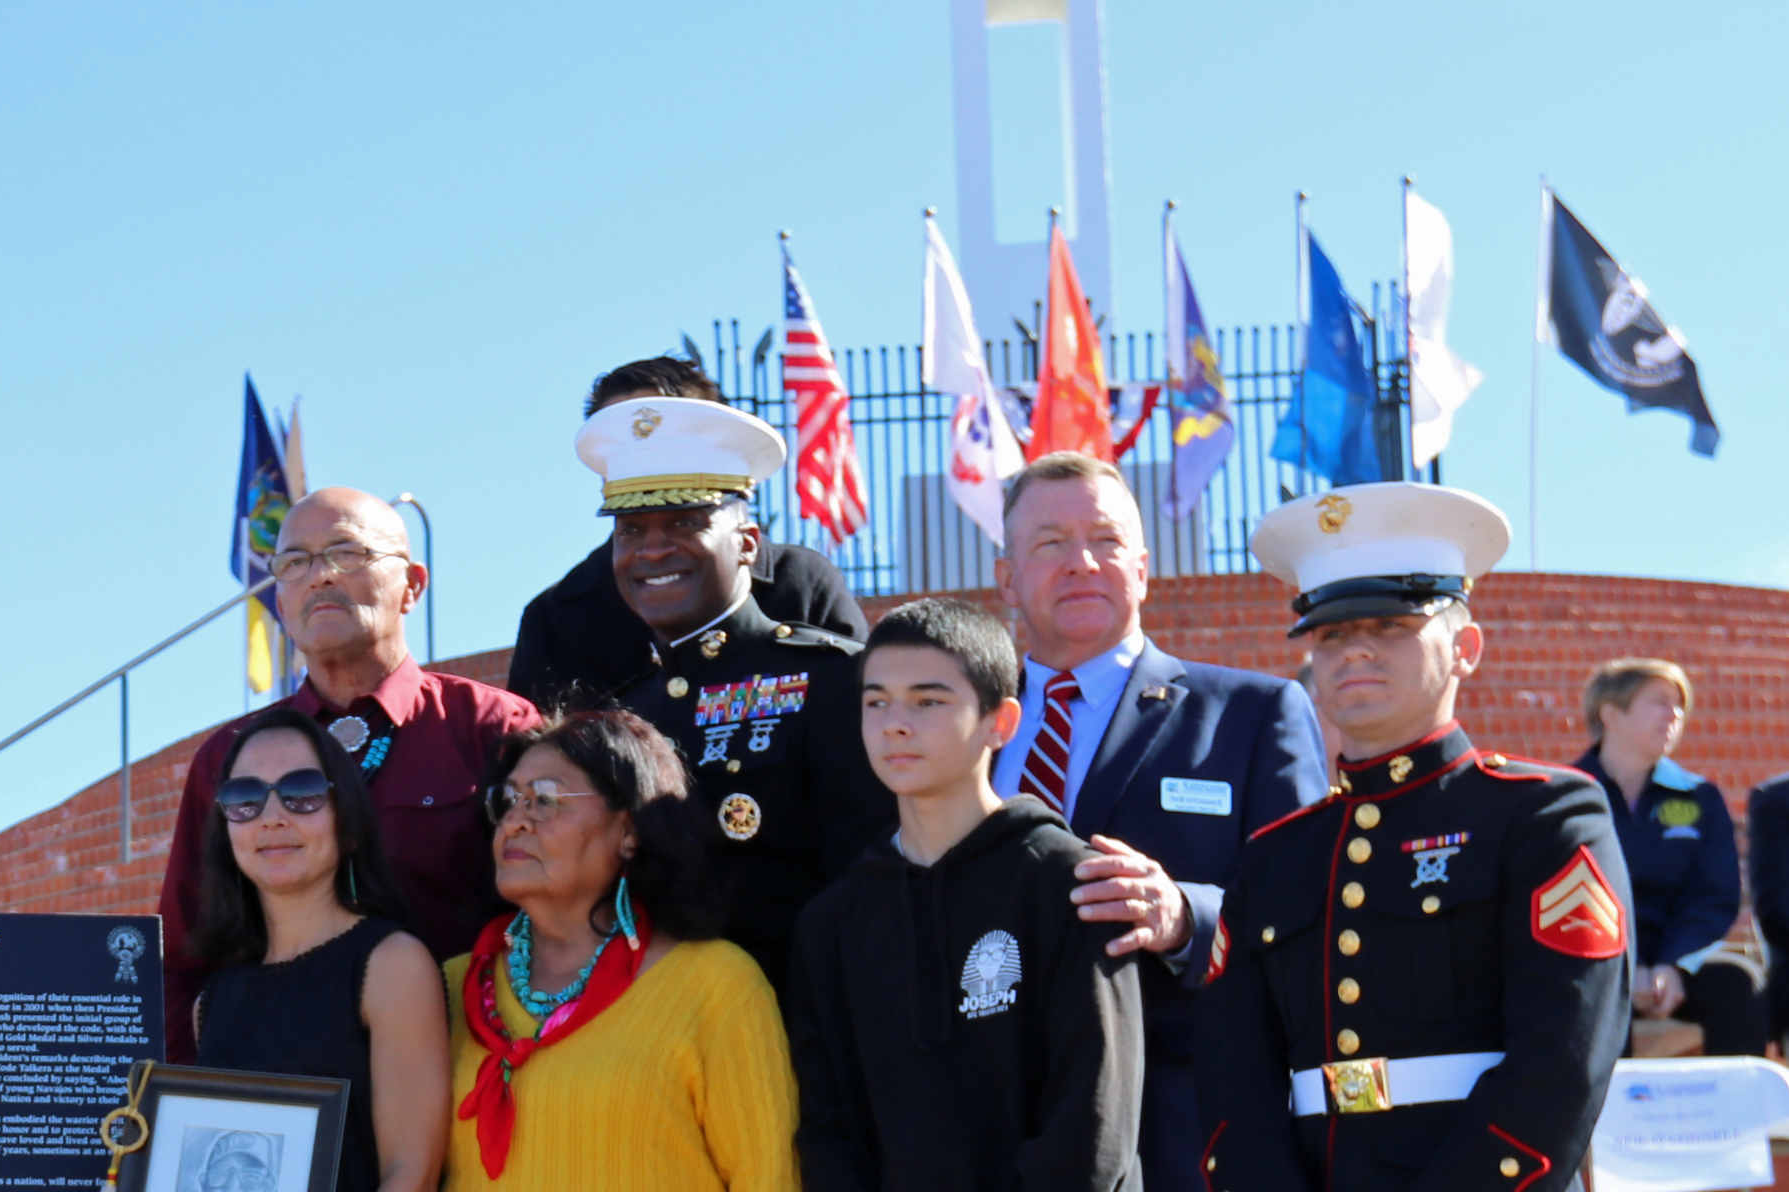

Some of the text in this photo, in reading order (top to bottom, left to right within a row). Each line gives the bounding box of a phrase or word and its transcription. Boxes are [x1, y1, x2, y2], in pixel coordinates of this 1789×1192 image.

[36, 993, 47, 1002] of
[48, 994, 70, 1002] their
[71, 995, 112, 1003] essential
[113, 995, 131, 1003] role
[959, 989, 1017, 1013] JOSEPH
[12, 1003, 22, 1011] in
[23, 1004, 45, 1012] 2001
[47, 1004, 72, 1012] when
[74, 1004, 95, 1012] then
[96, 1005, 139, 1013] President
